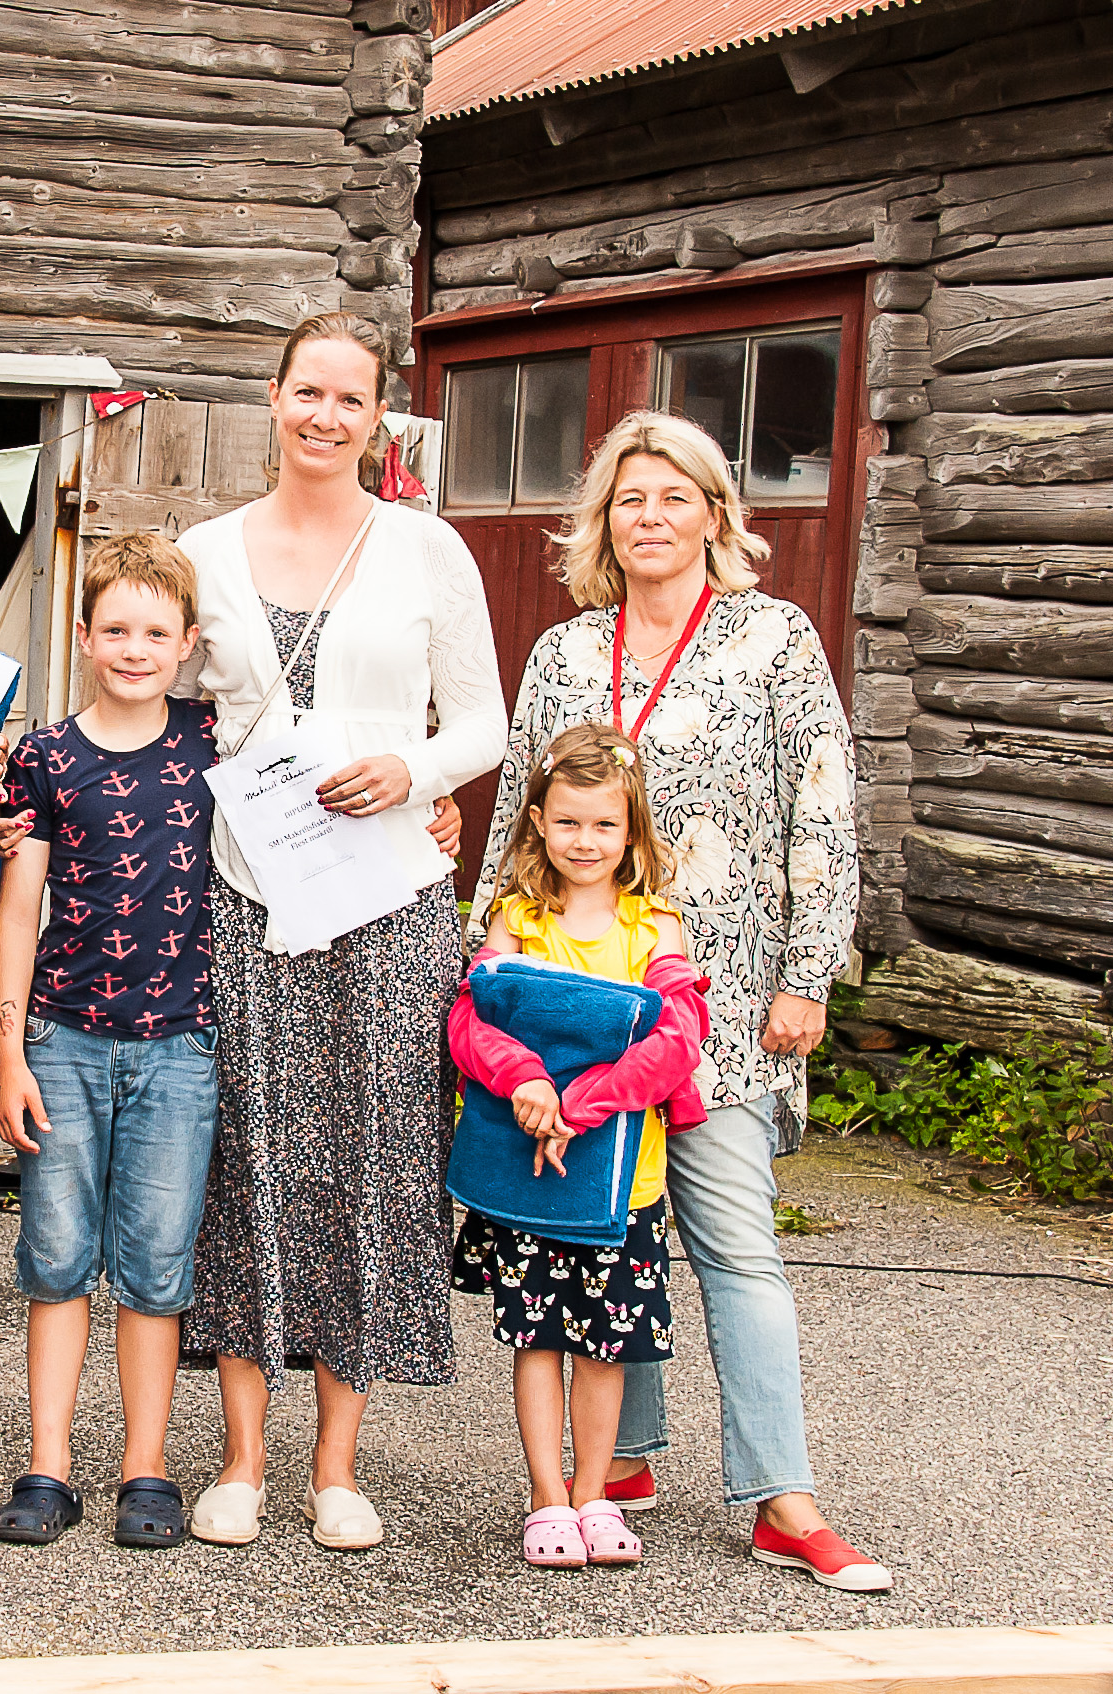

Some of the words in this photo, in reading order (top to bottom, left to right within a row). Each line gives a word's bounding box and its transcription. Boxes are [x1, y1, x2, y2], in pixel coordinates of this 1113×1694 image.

[284, 800, 313, 819] DIPLOM
[268, 839, 280, 850] SM
[283, 817, 328, 841] Makrillsfiske
[327, 810, 344, 822] 201
[290, 838, 309, 851] Flest
[309, 825, 334, 842] makrill
